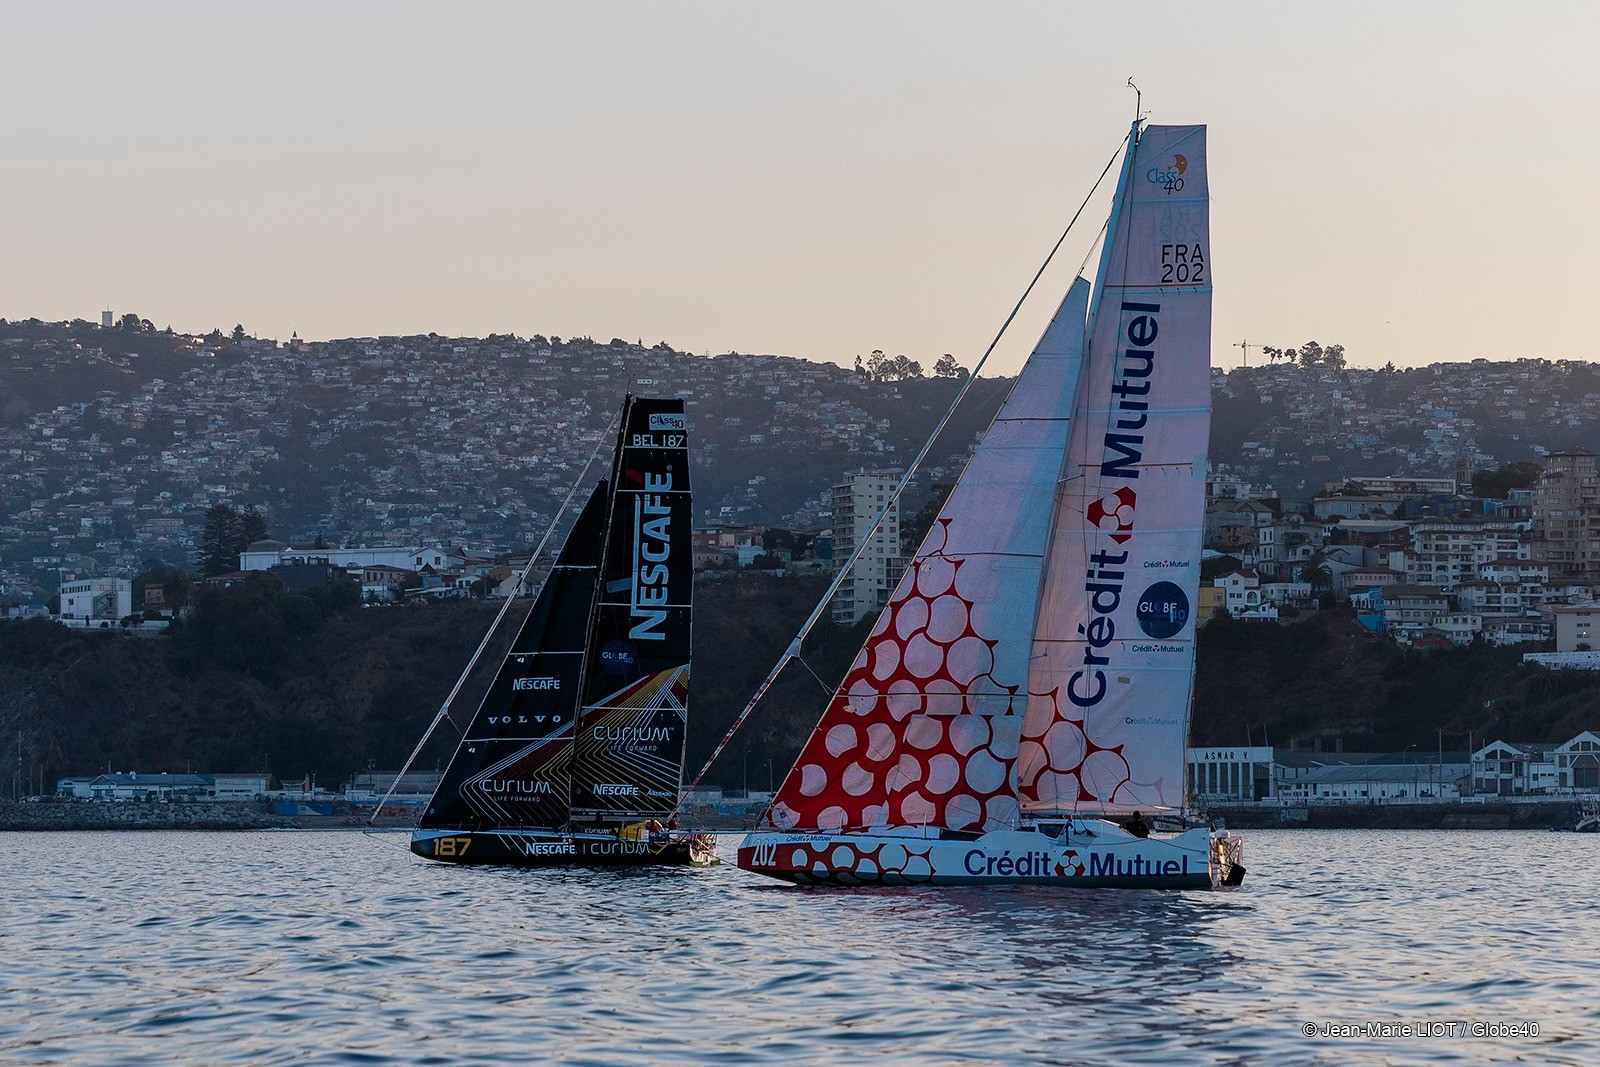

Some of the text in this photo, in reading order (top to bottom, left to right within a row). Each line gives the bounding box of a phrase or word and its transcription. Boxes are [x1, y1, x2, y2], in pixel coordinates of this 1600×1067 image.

[1147, 168, 1178, 184] Class
[1164, 178, 1185, 195] 40
[1161, 244, 1204, 263] FRA
[1161, 264, 1204, 283] 202
[672, 420, 684, 429] 40
[633, 434, 684, 447] BEL 187
[1067, 301, 1161, 707] Crédit Mutuel
[1143, 560, 1189, 568] Crédit Mutuel
[1132, 645, 1184, 653] Crédit Mutuel
[488, 715, 562, 724] VOLVO
[1205, 752, 1235, 760] ASMAR
[433, 838, 472, 856] 187
[751, 838, 778, 866] 202
[964, 849, 1189, 877] Crédit Mutuel
